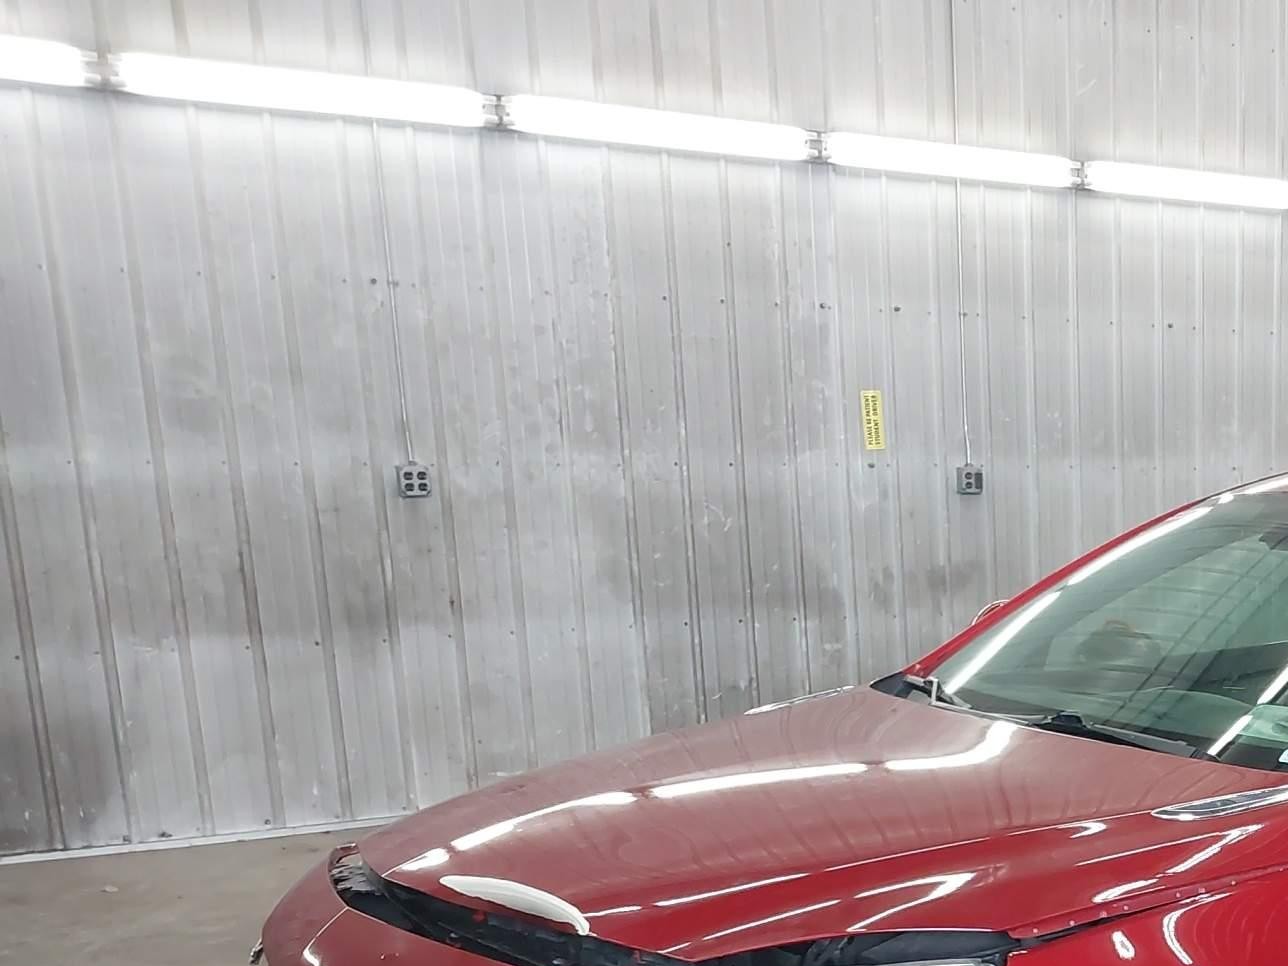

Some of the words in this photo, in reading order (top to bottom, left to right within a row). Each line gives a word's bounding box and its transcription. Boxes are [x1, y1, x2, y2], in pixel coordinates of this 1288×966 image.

[863, 395, 871, 417] PATIENT
[870, 395, 879, 416] DRIVER
[866, 426, 874, 445] PLEASE
[873, 419, 881, 445] STUDENT
